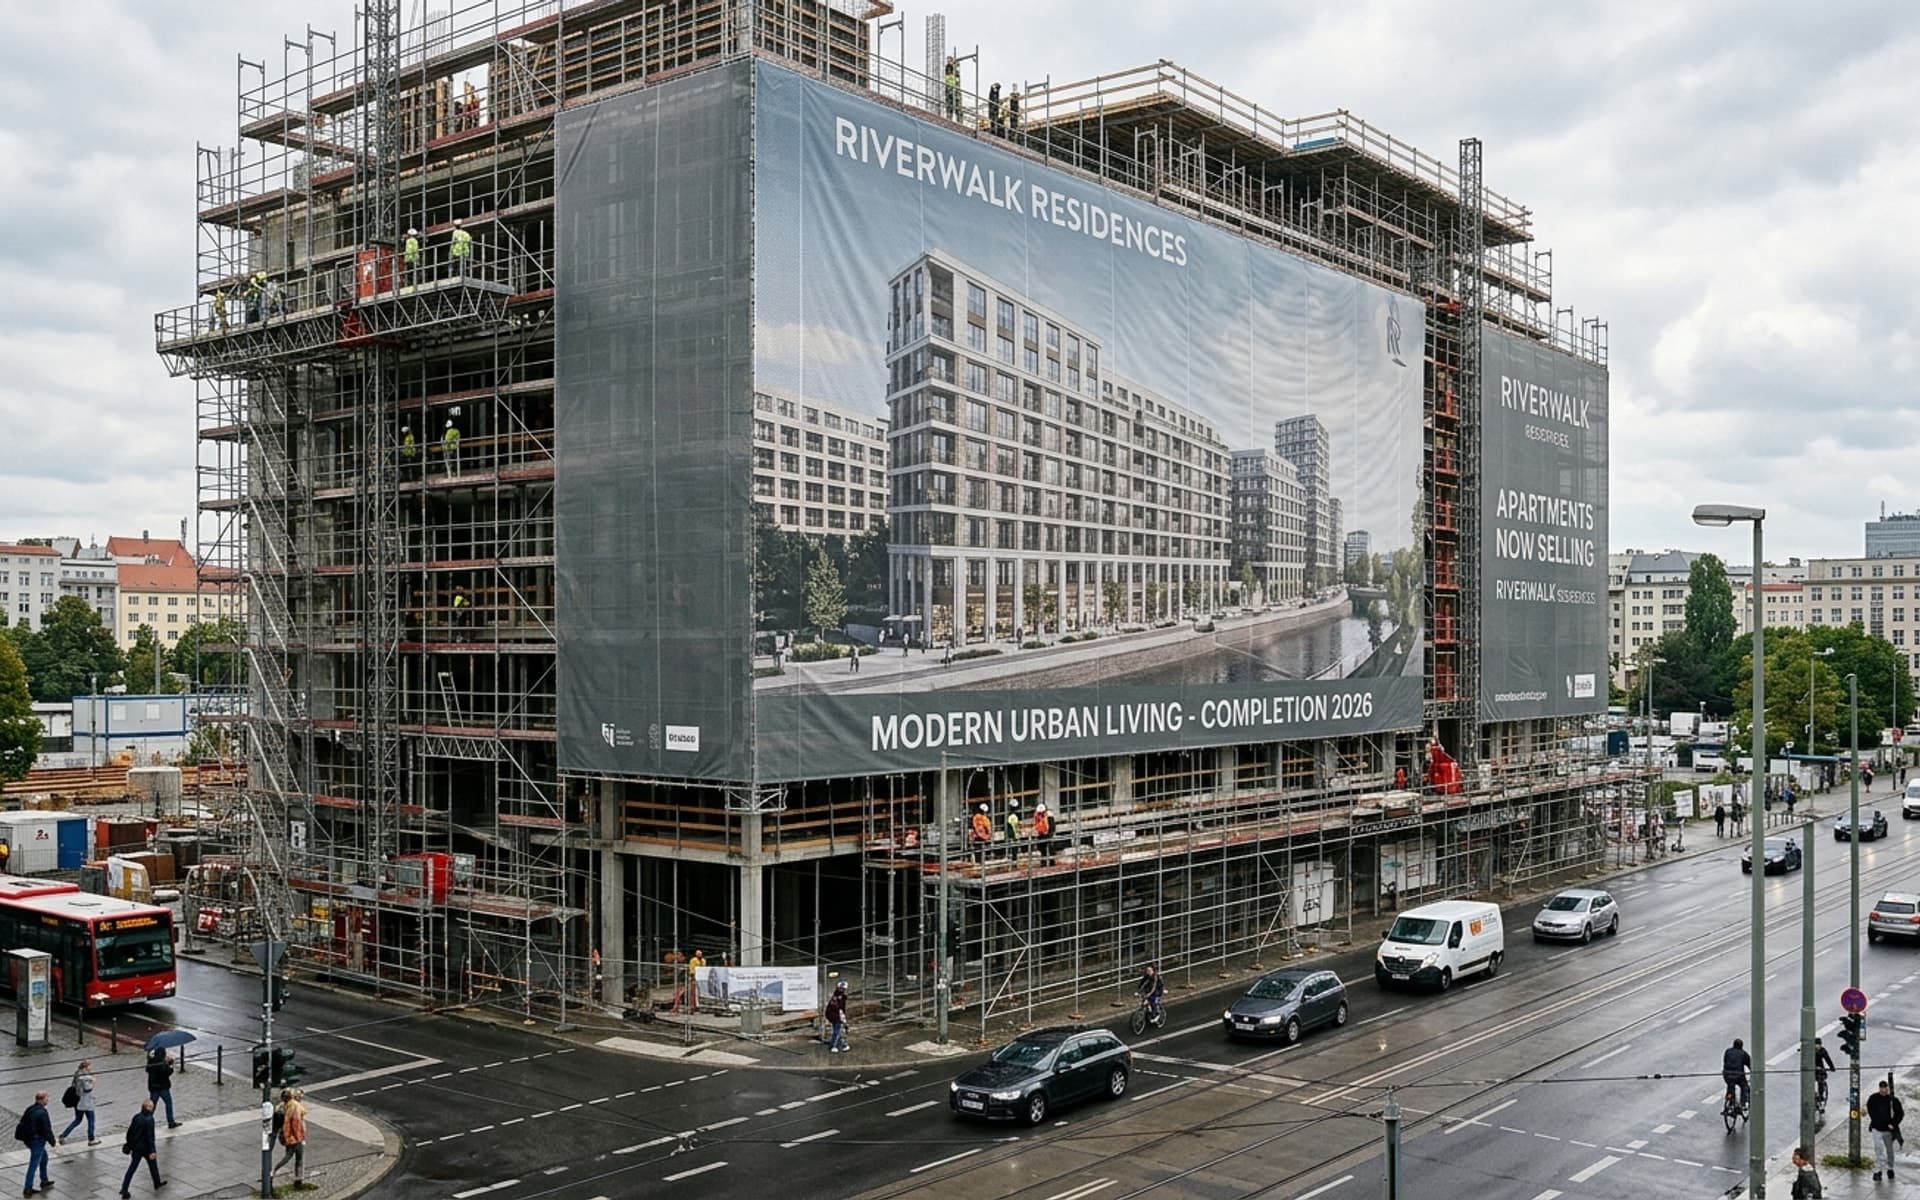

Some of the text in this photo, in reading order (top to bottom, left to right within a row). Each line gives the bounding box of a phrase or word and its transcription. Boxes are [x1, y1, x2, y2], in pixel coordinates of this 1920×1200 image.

[835, 116, 1188, 267] RIVERWALK RESIDENCES
[1501, 375, 1590, 430] RIVERWALK
[1496, 488, 1594, 531] APARTMENTS
[1496, 528, 1595, 567] NOW SELLING
[1496, 579, 1557, 602] RIVERWALK
[871, 710, 1003, 752] MODERN
[1011, 705, 1099, 742] URBAN
[1106, 701, 1183, 735] LIVING
[1200, 694, 1328, 729] COMPLETION
[1331, 692, 1373, 720] 2026
